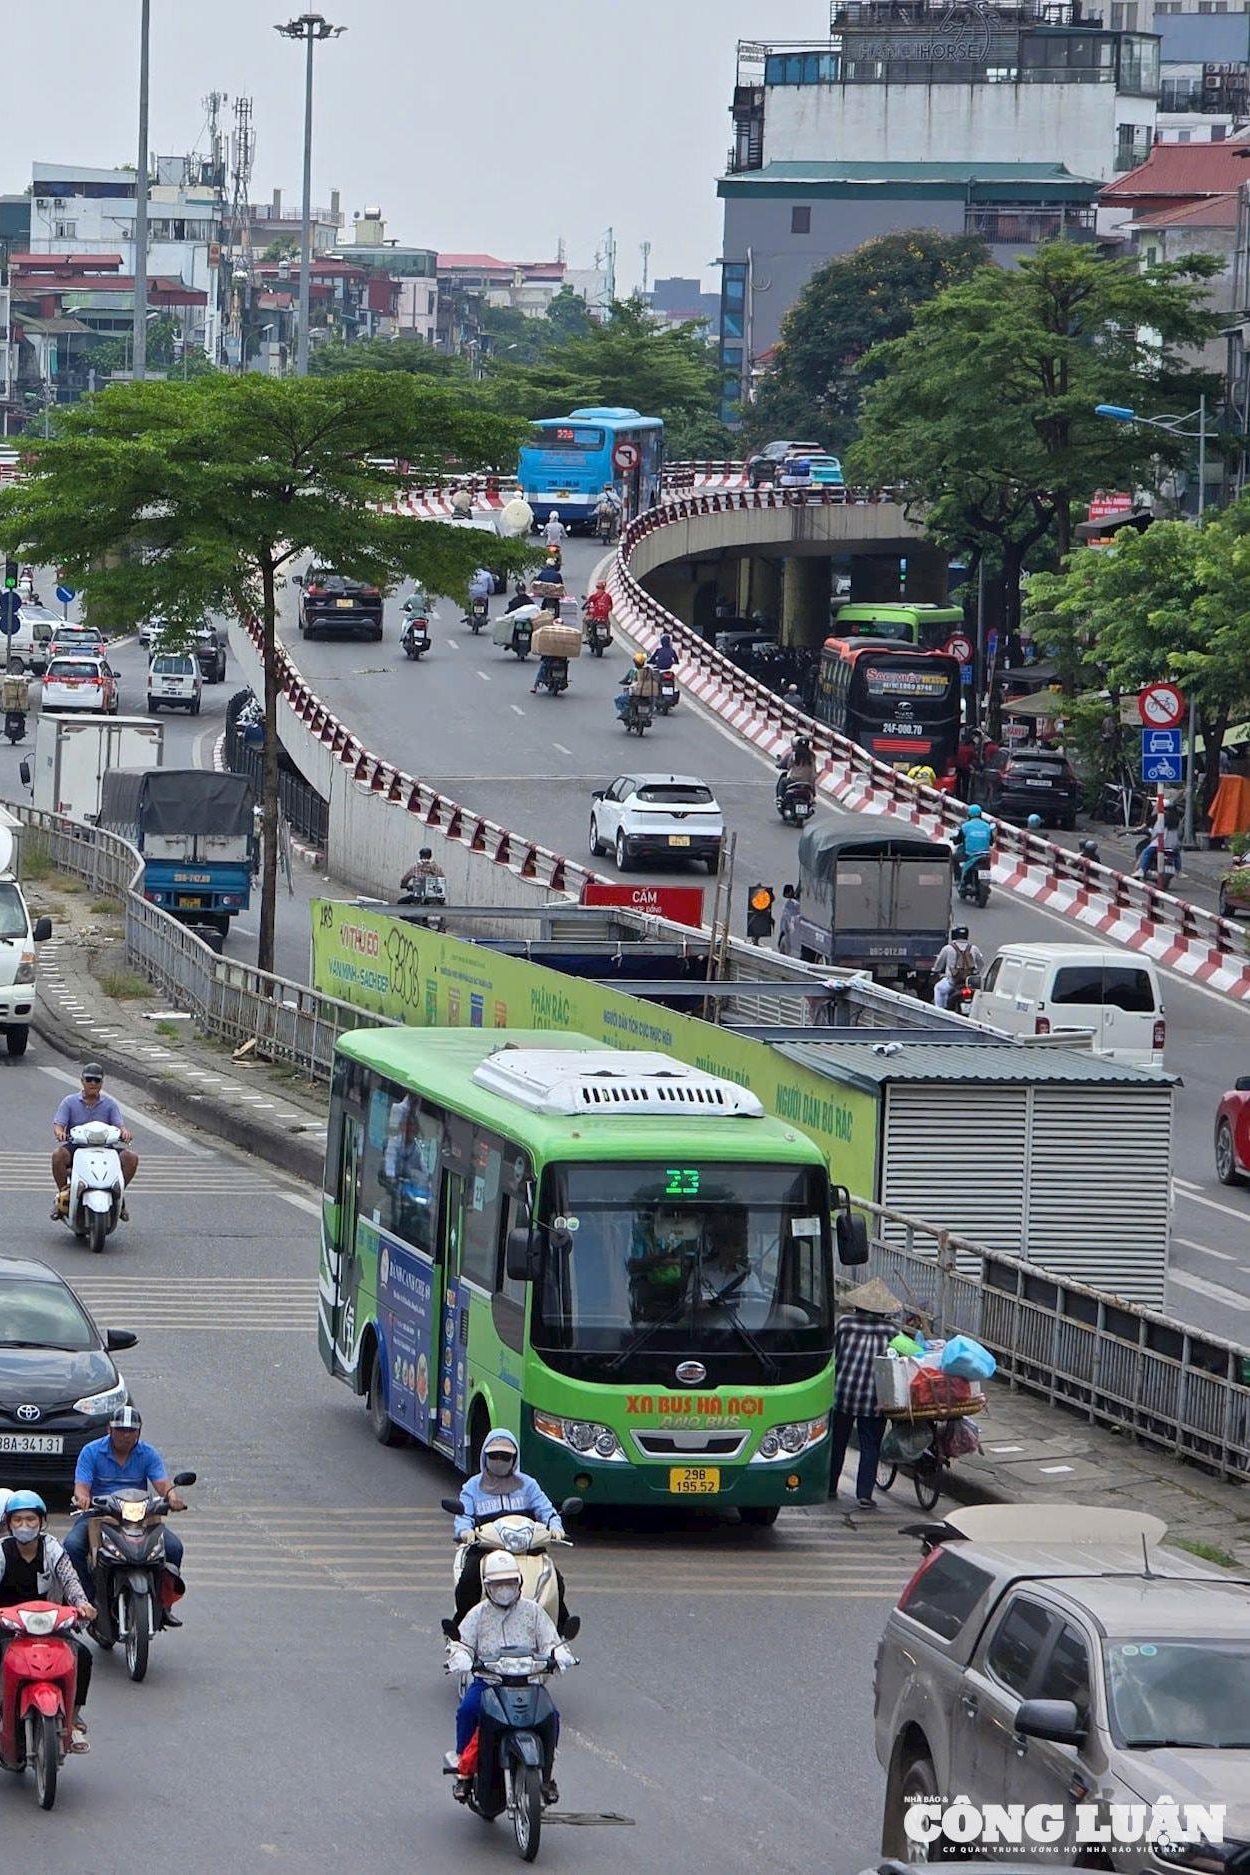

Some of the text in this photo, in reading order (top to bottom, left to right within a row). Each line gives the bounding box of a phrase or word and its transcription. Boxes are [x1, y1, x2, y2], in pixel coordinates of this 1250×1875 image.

[920, 43, 980, 59] HORSE
[631, 887, 657, 904] CẤM
[531, 987, 570, 1026] PHÂN RÁC
[776, 1083, 854, 1143] NGƯỜI DÂN BỎ RÁC
[665, 1169, 700, 1194] 23
[658, 1395, 692, 1415] BUS
[697, 1393, 722, 1415] HÀ
[705, 1415, 741, 1429] BUS
[684, 1469, 705, 1480] 29B
[677, 1481, 715, 1493] 195.52
